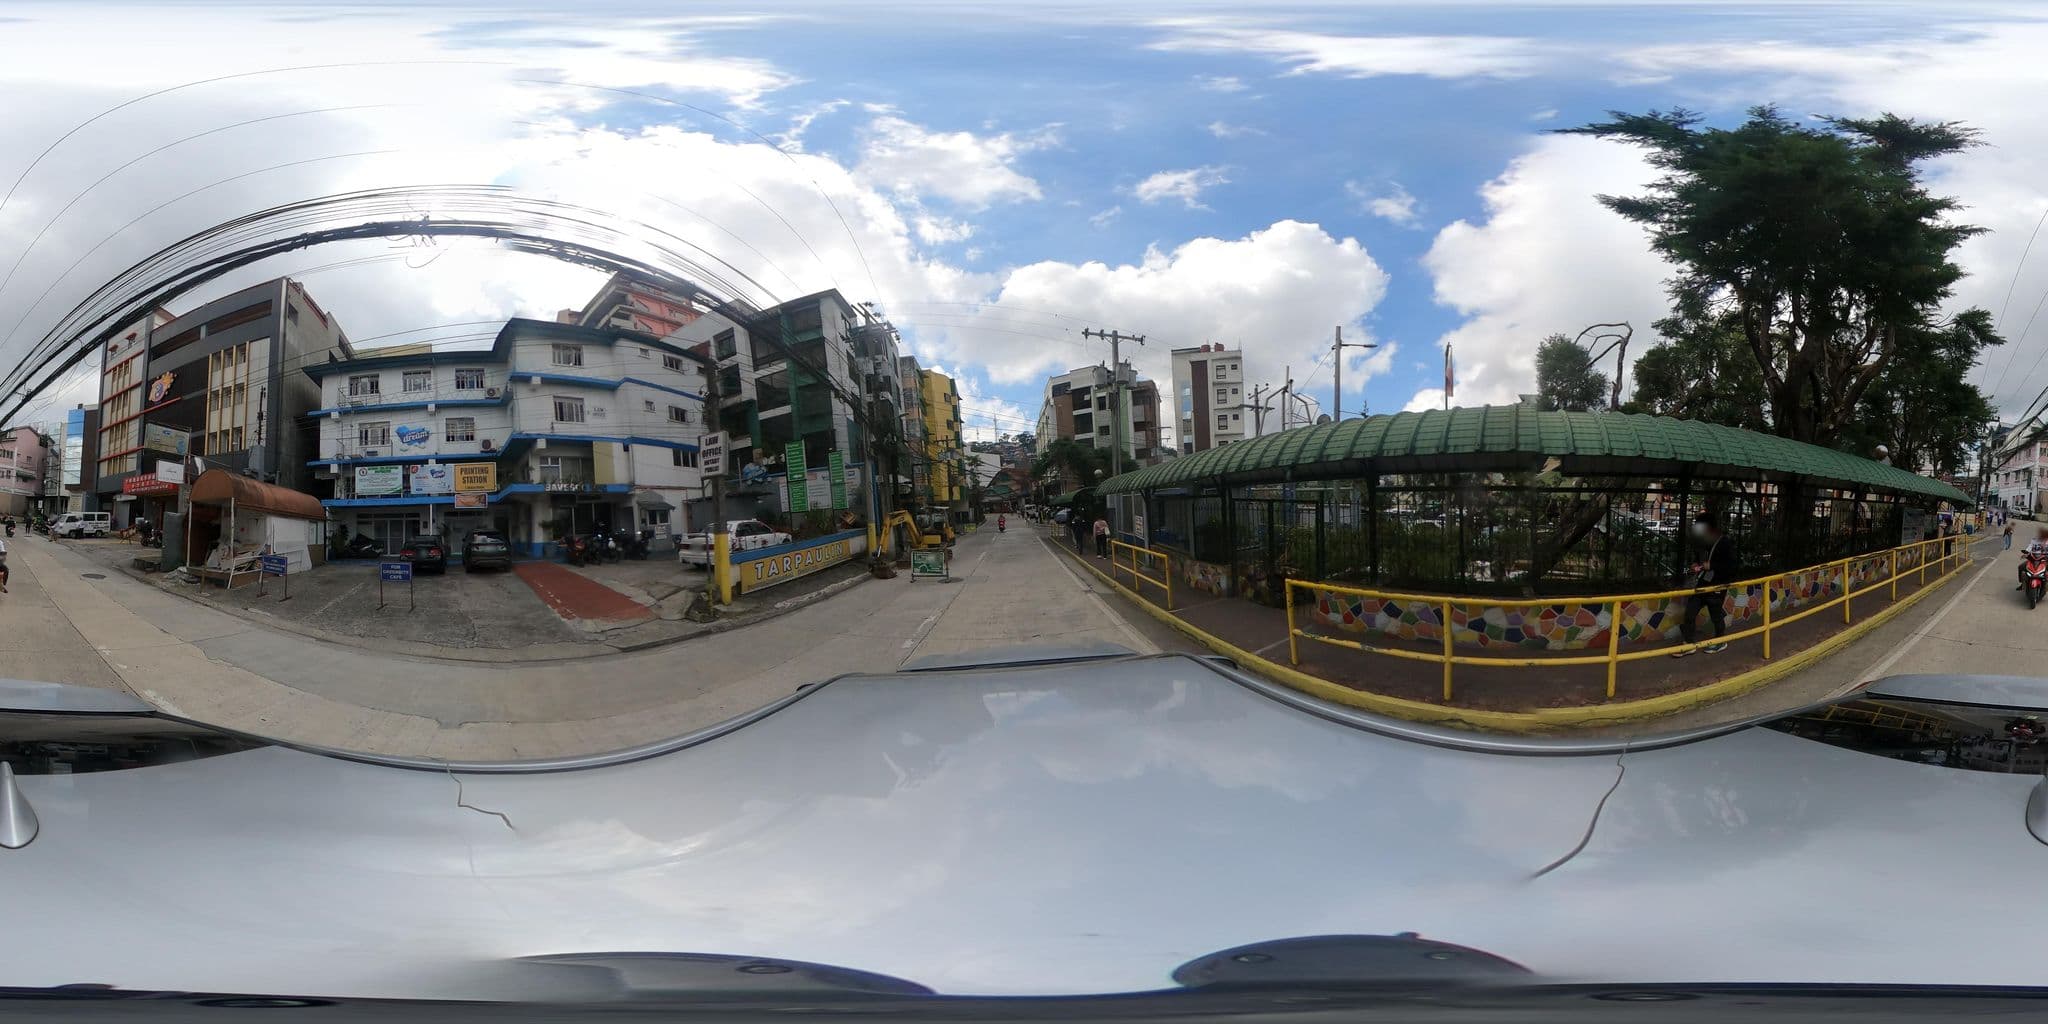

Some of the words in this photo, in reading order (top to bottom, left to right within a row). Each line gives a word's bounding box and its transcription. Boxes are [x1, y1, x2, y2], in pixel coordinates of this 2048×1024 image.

[705, 436, 719, 446] LAW
[702, 446, 722, 458] OFFICE
[460, 467, 489, 475] PRINTING
[462, 475, 488, 484] STATION
[755, 542, 844, 580] TARPAULIN
